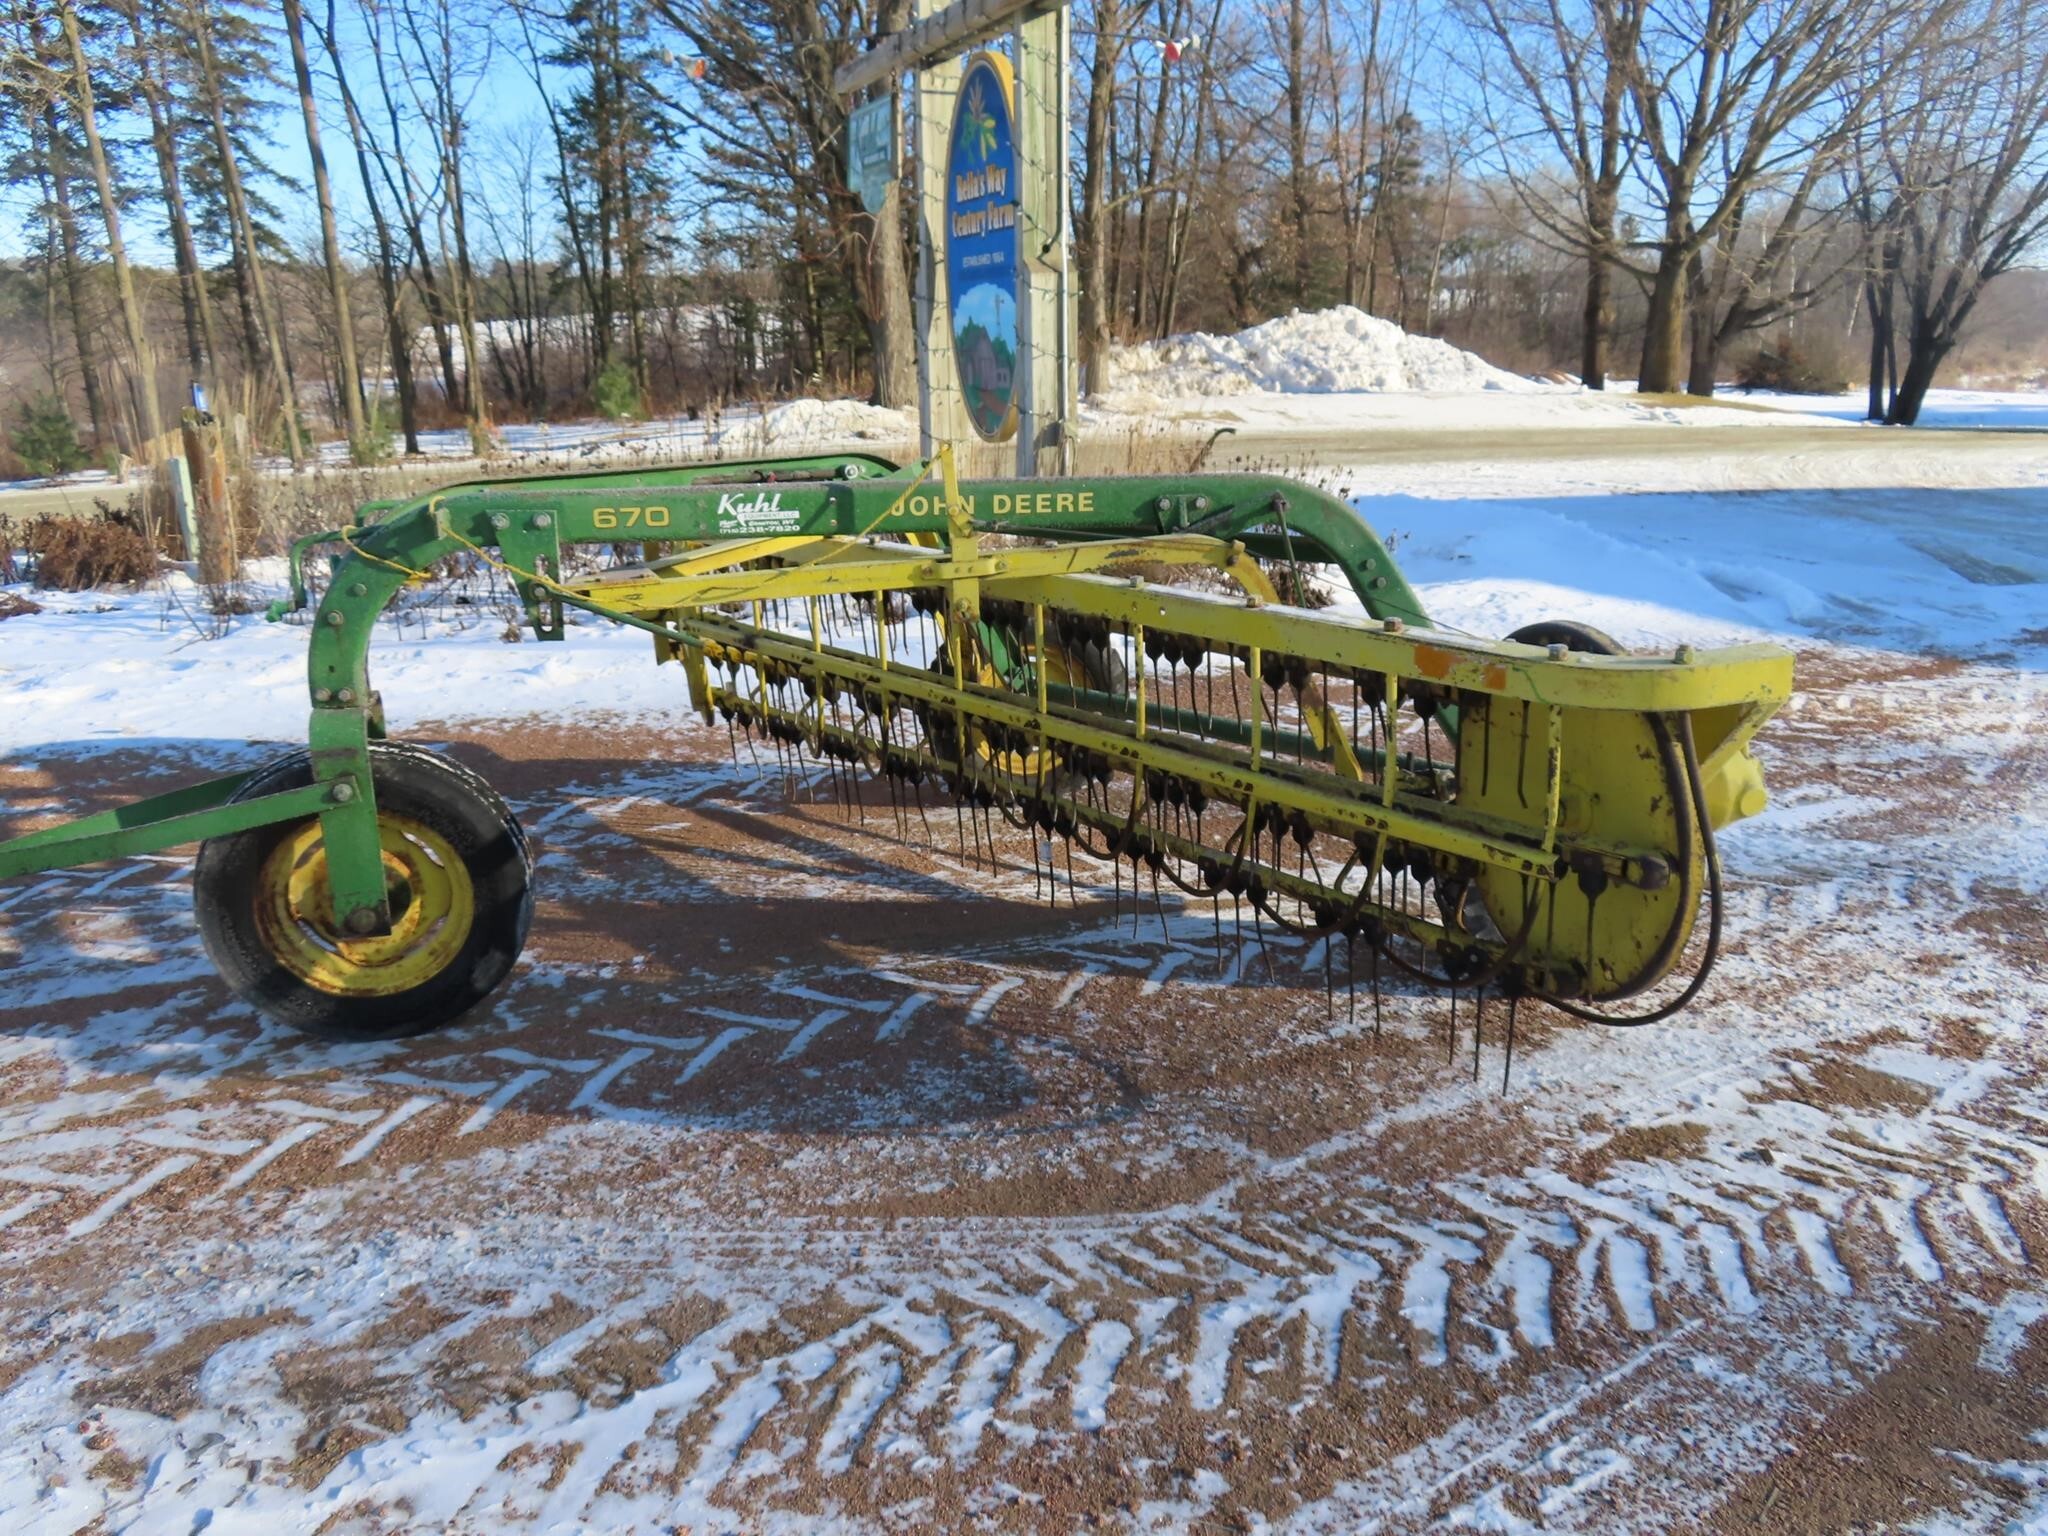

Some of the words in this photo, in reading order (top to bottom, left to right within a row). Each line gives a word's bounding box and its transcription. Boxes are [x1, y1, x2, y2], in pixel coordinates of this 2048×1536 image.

[986, 165, 1006, 195] Way
[952, 210, 985, 238] Century
[987, 201, 1014, 230] Farm
[593, 506, 669, 528] 670
[717, 493, 781, 516] Kuhl
[891, 495, 975, 517] JOHN
[993, 492, 1094, 515] DEERE
